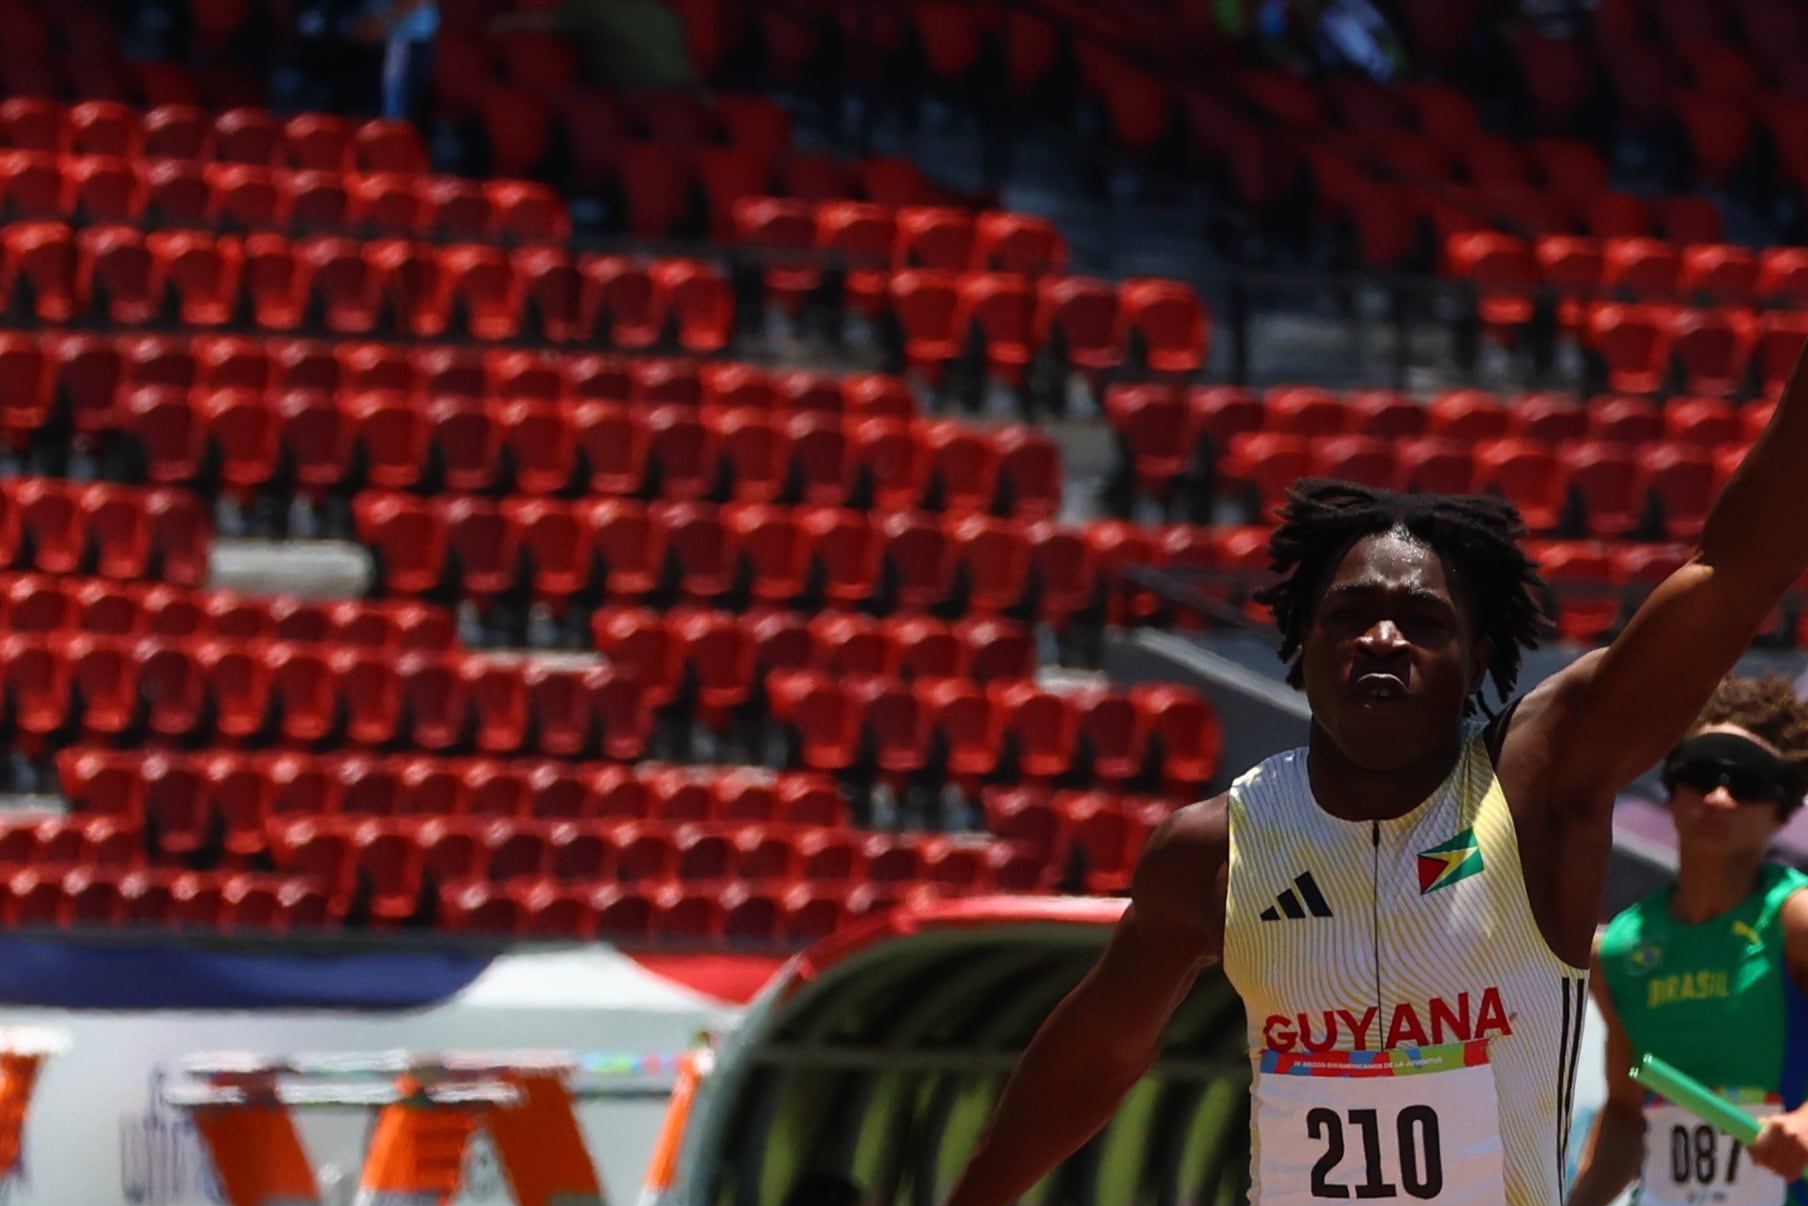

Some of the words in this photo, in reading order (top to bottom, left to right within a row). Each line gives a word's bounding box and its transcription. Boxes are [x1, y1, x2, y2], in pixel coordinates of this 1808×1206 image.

[1262, 986, 1512, 1053] GUYANA
[1647, 971, 1729, 1009] BRASIL
[1306, 1105, 1443, 1199] 210
[1672, 1124, 1743, 1185] 087
